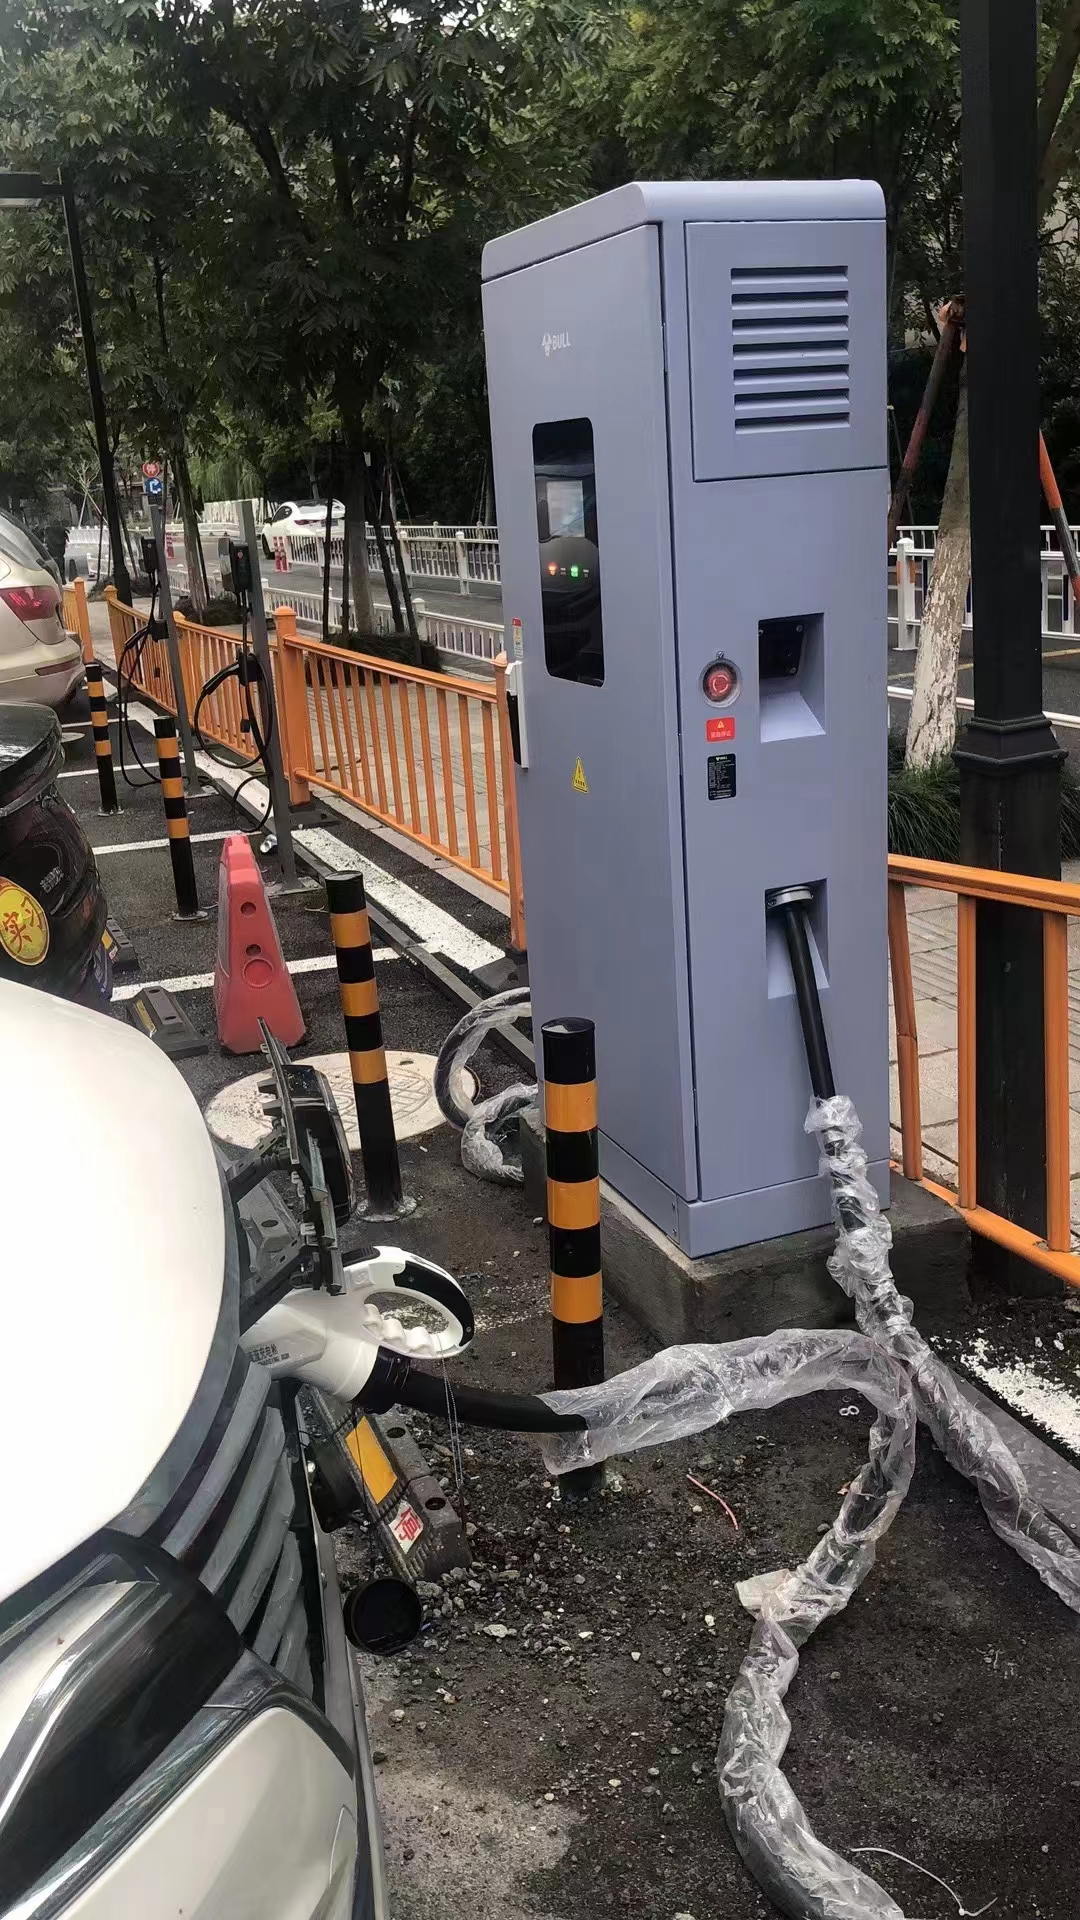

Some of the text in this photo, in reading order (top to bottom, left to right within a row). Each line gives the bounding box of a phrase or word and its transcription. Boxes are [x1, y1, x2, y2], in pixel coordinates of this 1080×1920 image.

[552, 332, 571, 350] BULL
[2, 896, 43, 954] 实习
[394, 1507, 421, 1541] 停
